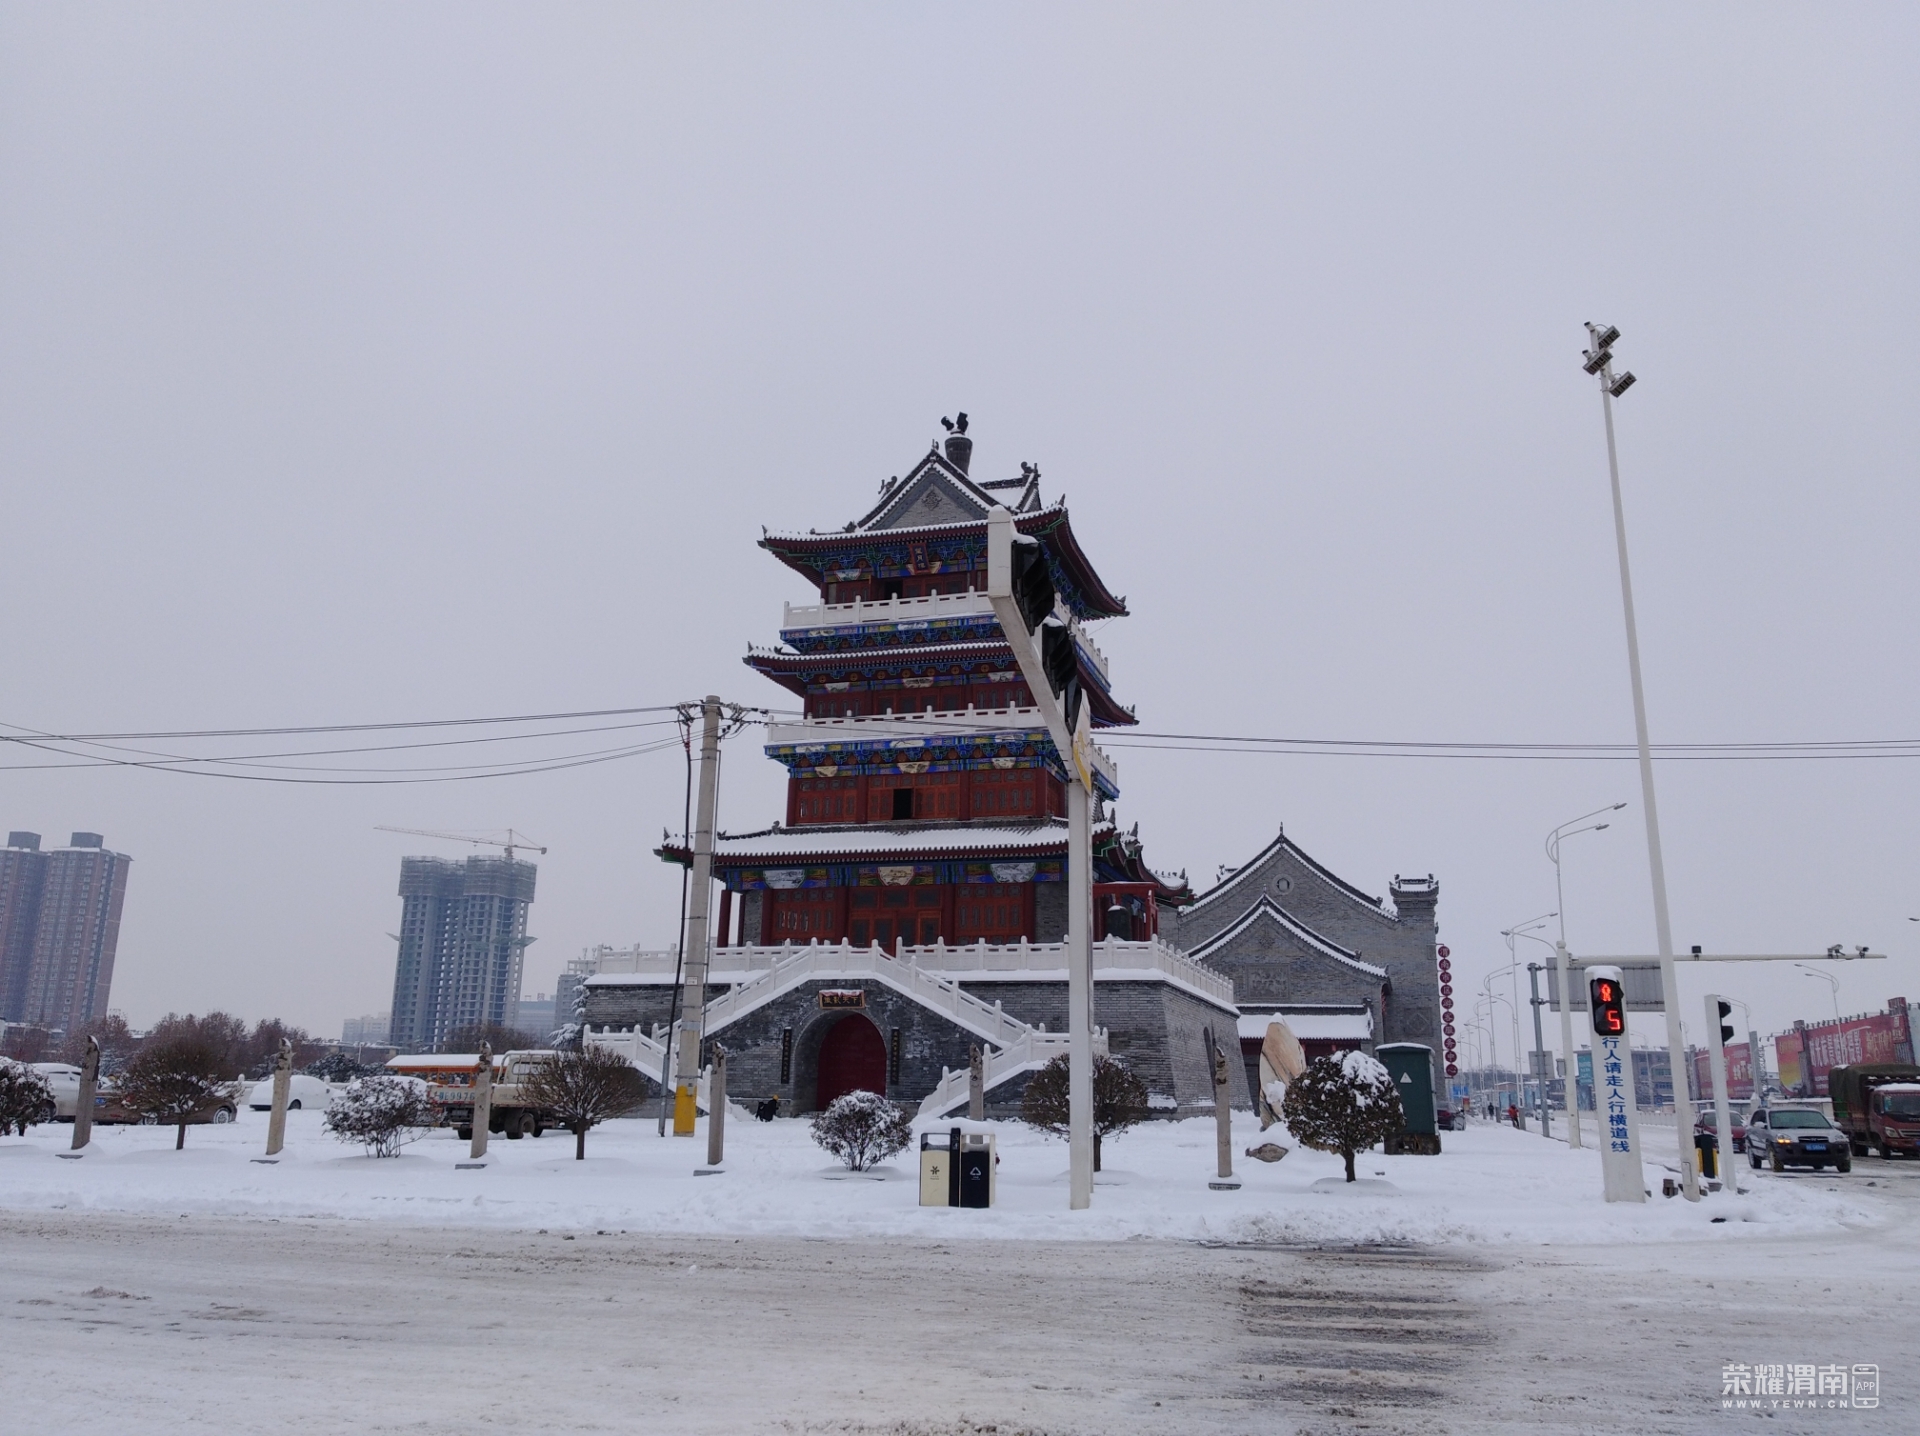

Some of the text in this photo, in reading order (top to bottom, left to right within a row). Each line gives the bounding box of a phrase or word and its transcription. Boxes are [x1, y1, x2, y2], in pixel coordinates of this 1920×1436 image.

[1606, 1010, 1621, 1030] 5
[1602, 1037, 1630, 1153] 行人请走人行横道线
